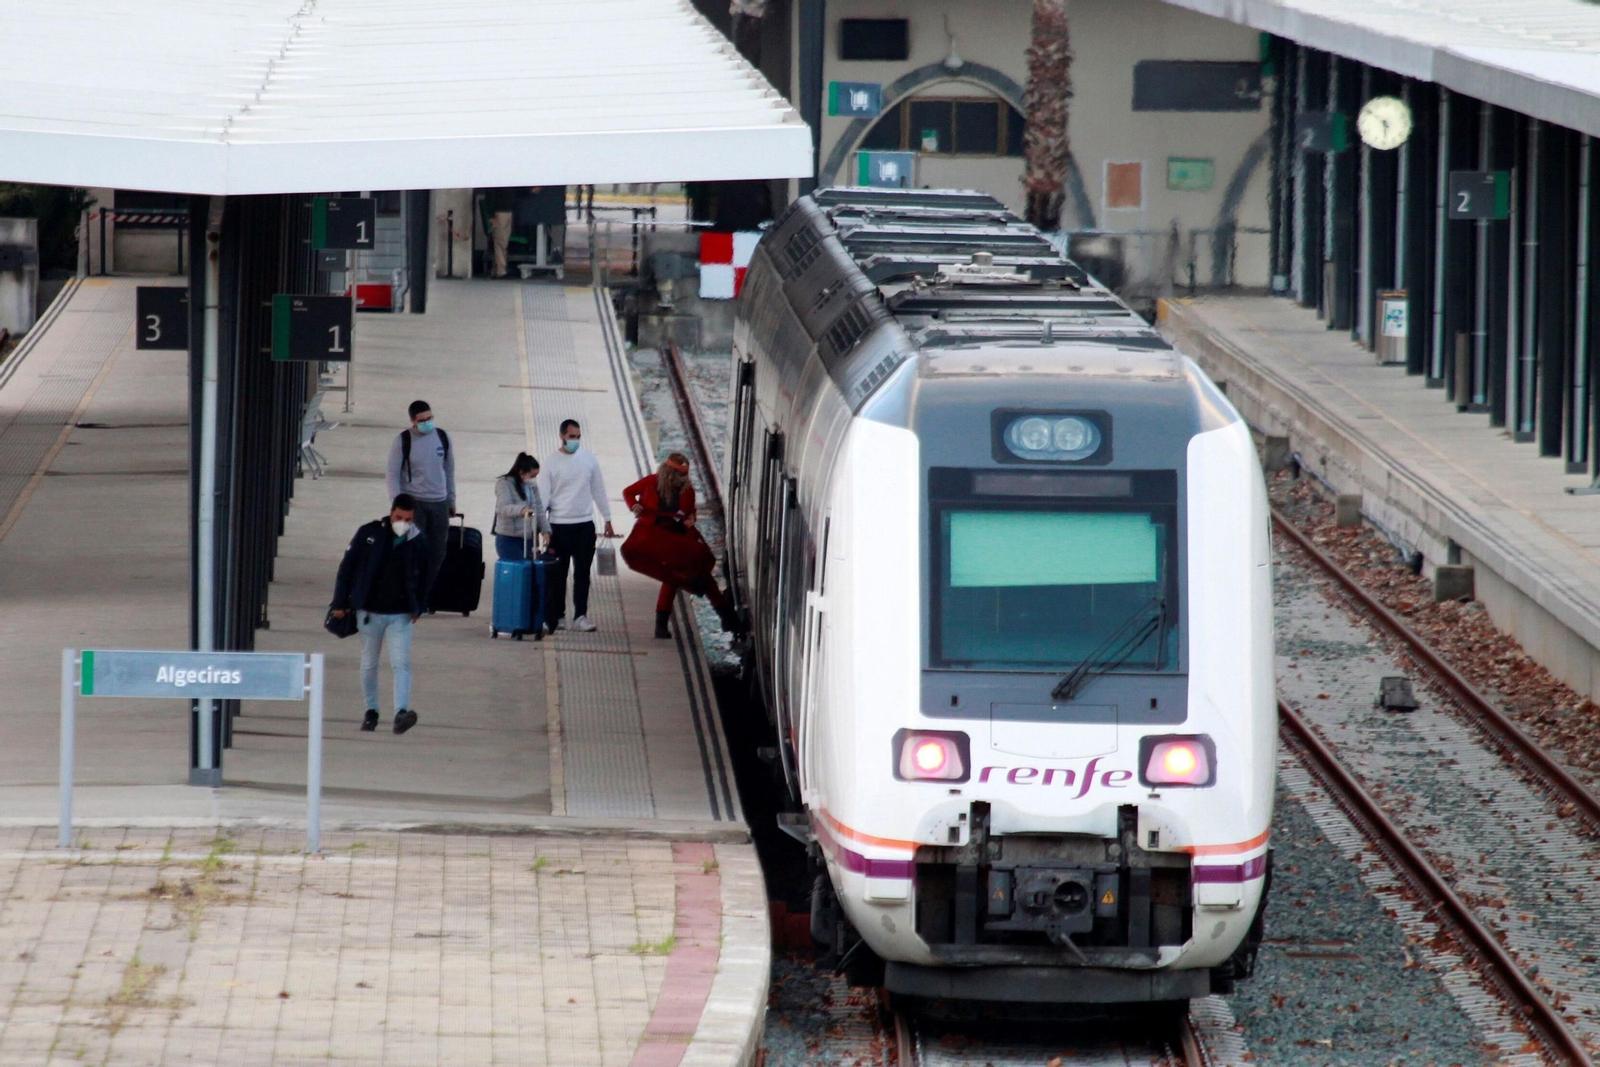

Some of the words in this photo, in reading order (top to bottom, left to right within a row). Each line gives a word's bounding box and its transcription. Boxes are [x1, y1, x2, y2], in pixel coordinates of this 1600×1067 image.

[1457, 192, 1470, 212] 2
[356, 220, 370, 243] 1
[145, 314, 161, 342] 3
[328, 325, 345, 353] 1
[156, 665, 241, 687] Algeciras
[978, 756, 1133, 800] renfe
